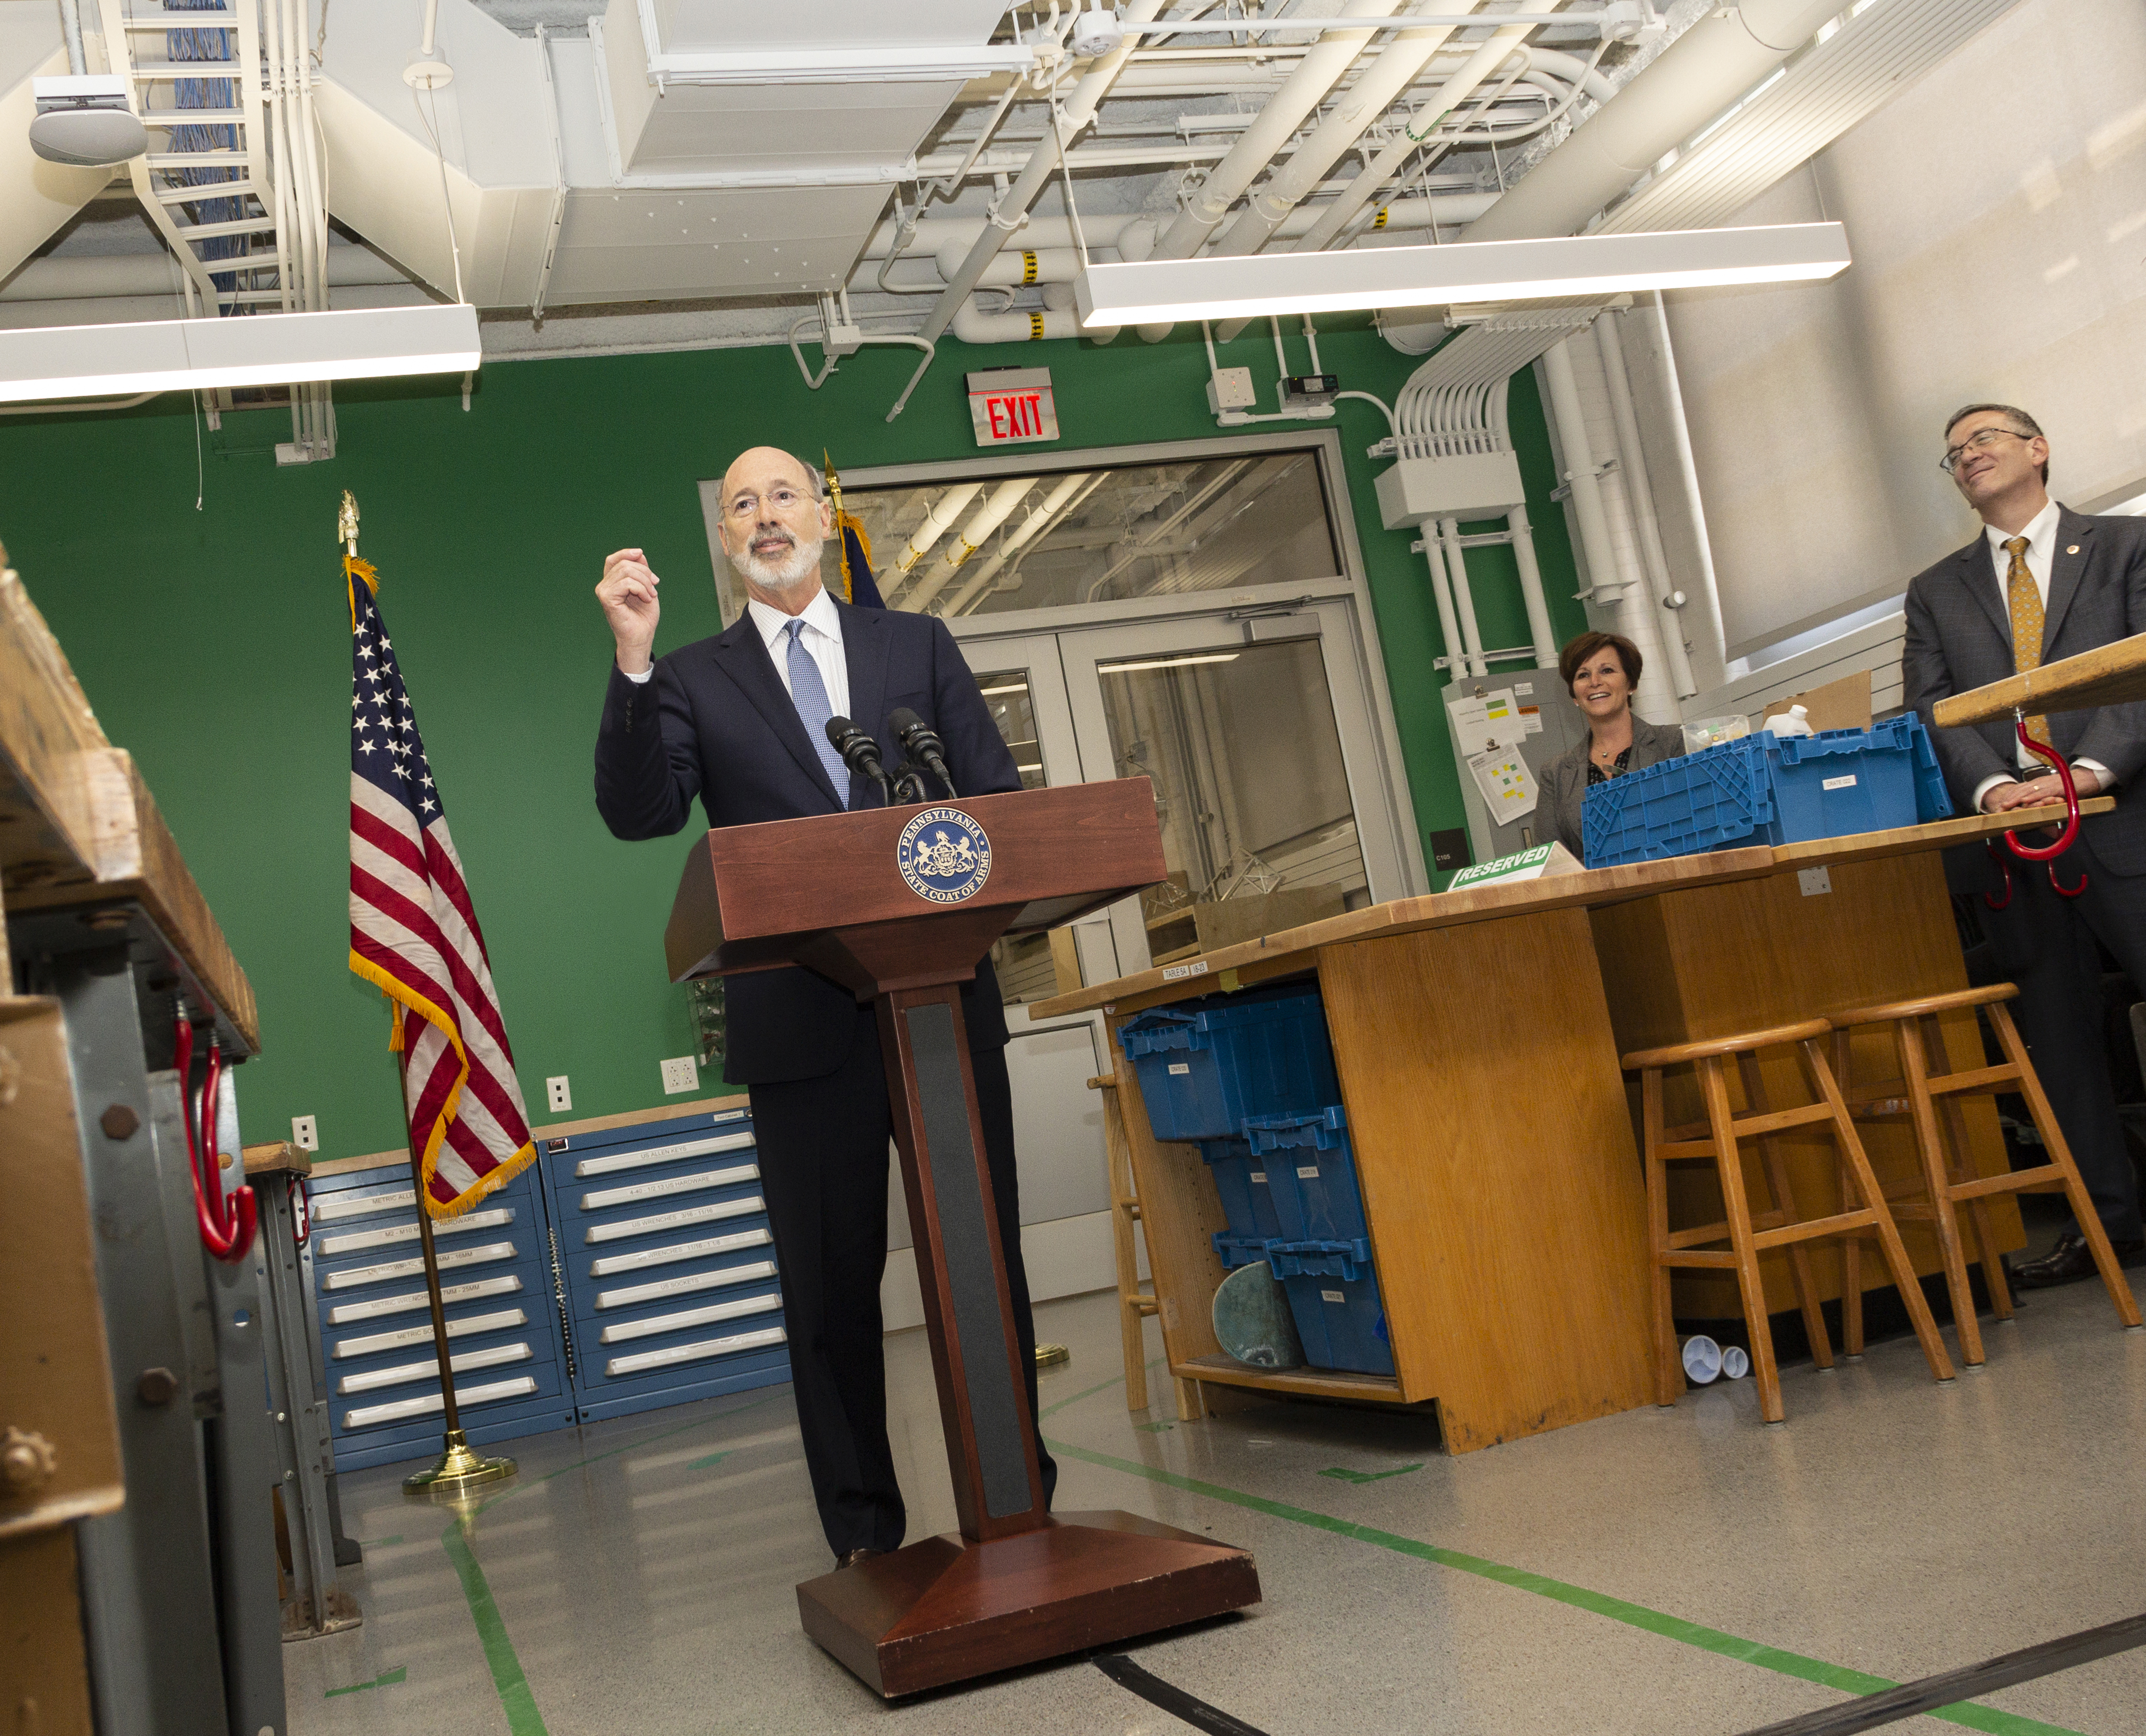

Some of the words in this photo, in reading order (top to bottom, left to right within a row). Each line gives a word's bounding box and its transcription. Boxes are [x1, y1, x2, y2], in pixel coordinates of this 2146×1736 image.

[986, 394, 1042, 439] EXIT
[901, 810, 981, 848] PENNSYLVANIA
[1458, 845, 1549, 882] RESERVED
[901, 861, 928, 895] STATE
[929, 891, 960, 901] COAT
[961, 883, 976, 896] OF
[975, 851, 989, 885] ARMS
[1165, 968, 1180, 978] TABLE
[1180, 967, 1187, 975] 5A
[1193, 963, 1205, 974] 18-23
[675, 1176, 710, 1187] HARDWARE
[372, 1195, 396, 1204] METRIC
[642, 1215, 677, 1226] WRENCHES
[648, 1247, 683, 1259] WRENCHES
[368, 1264, 393, 1275] METRIC
[671, 1278, 699, 1288] SOCKETS
[462, 1285, 480, 1293] 25MM
[371, 1299, 396, 1308] METRIC
[397, 1331, 422, 1339] METRIC
